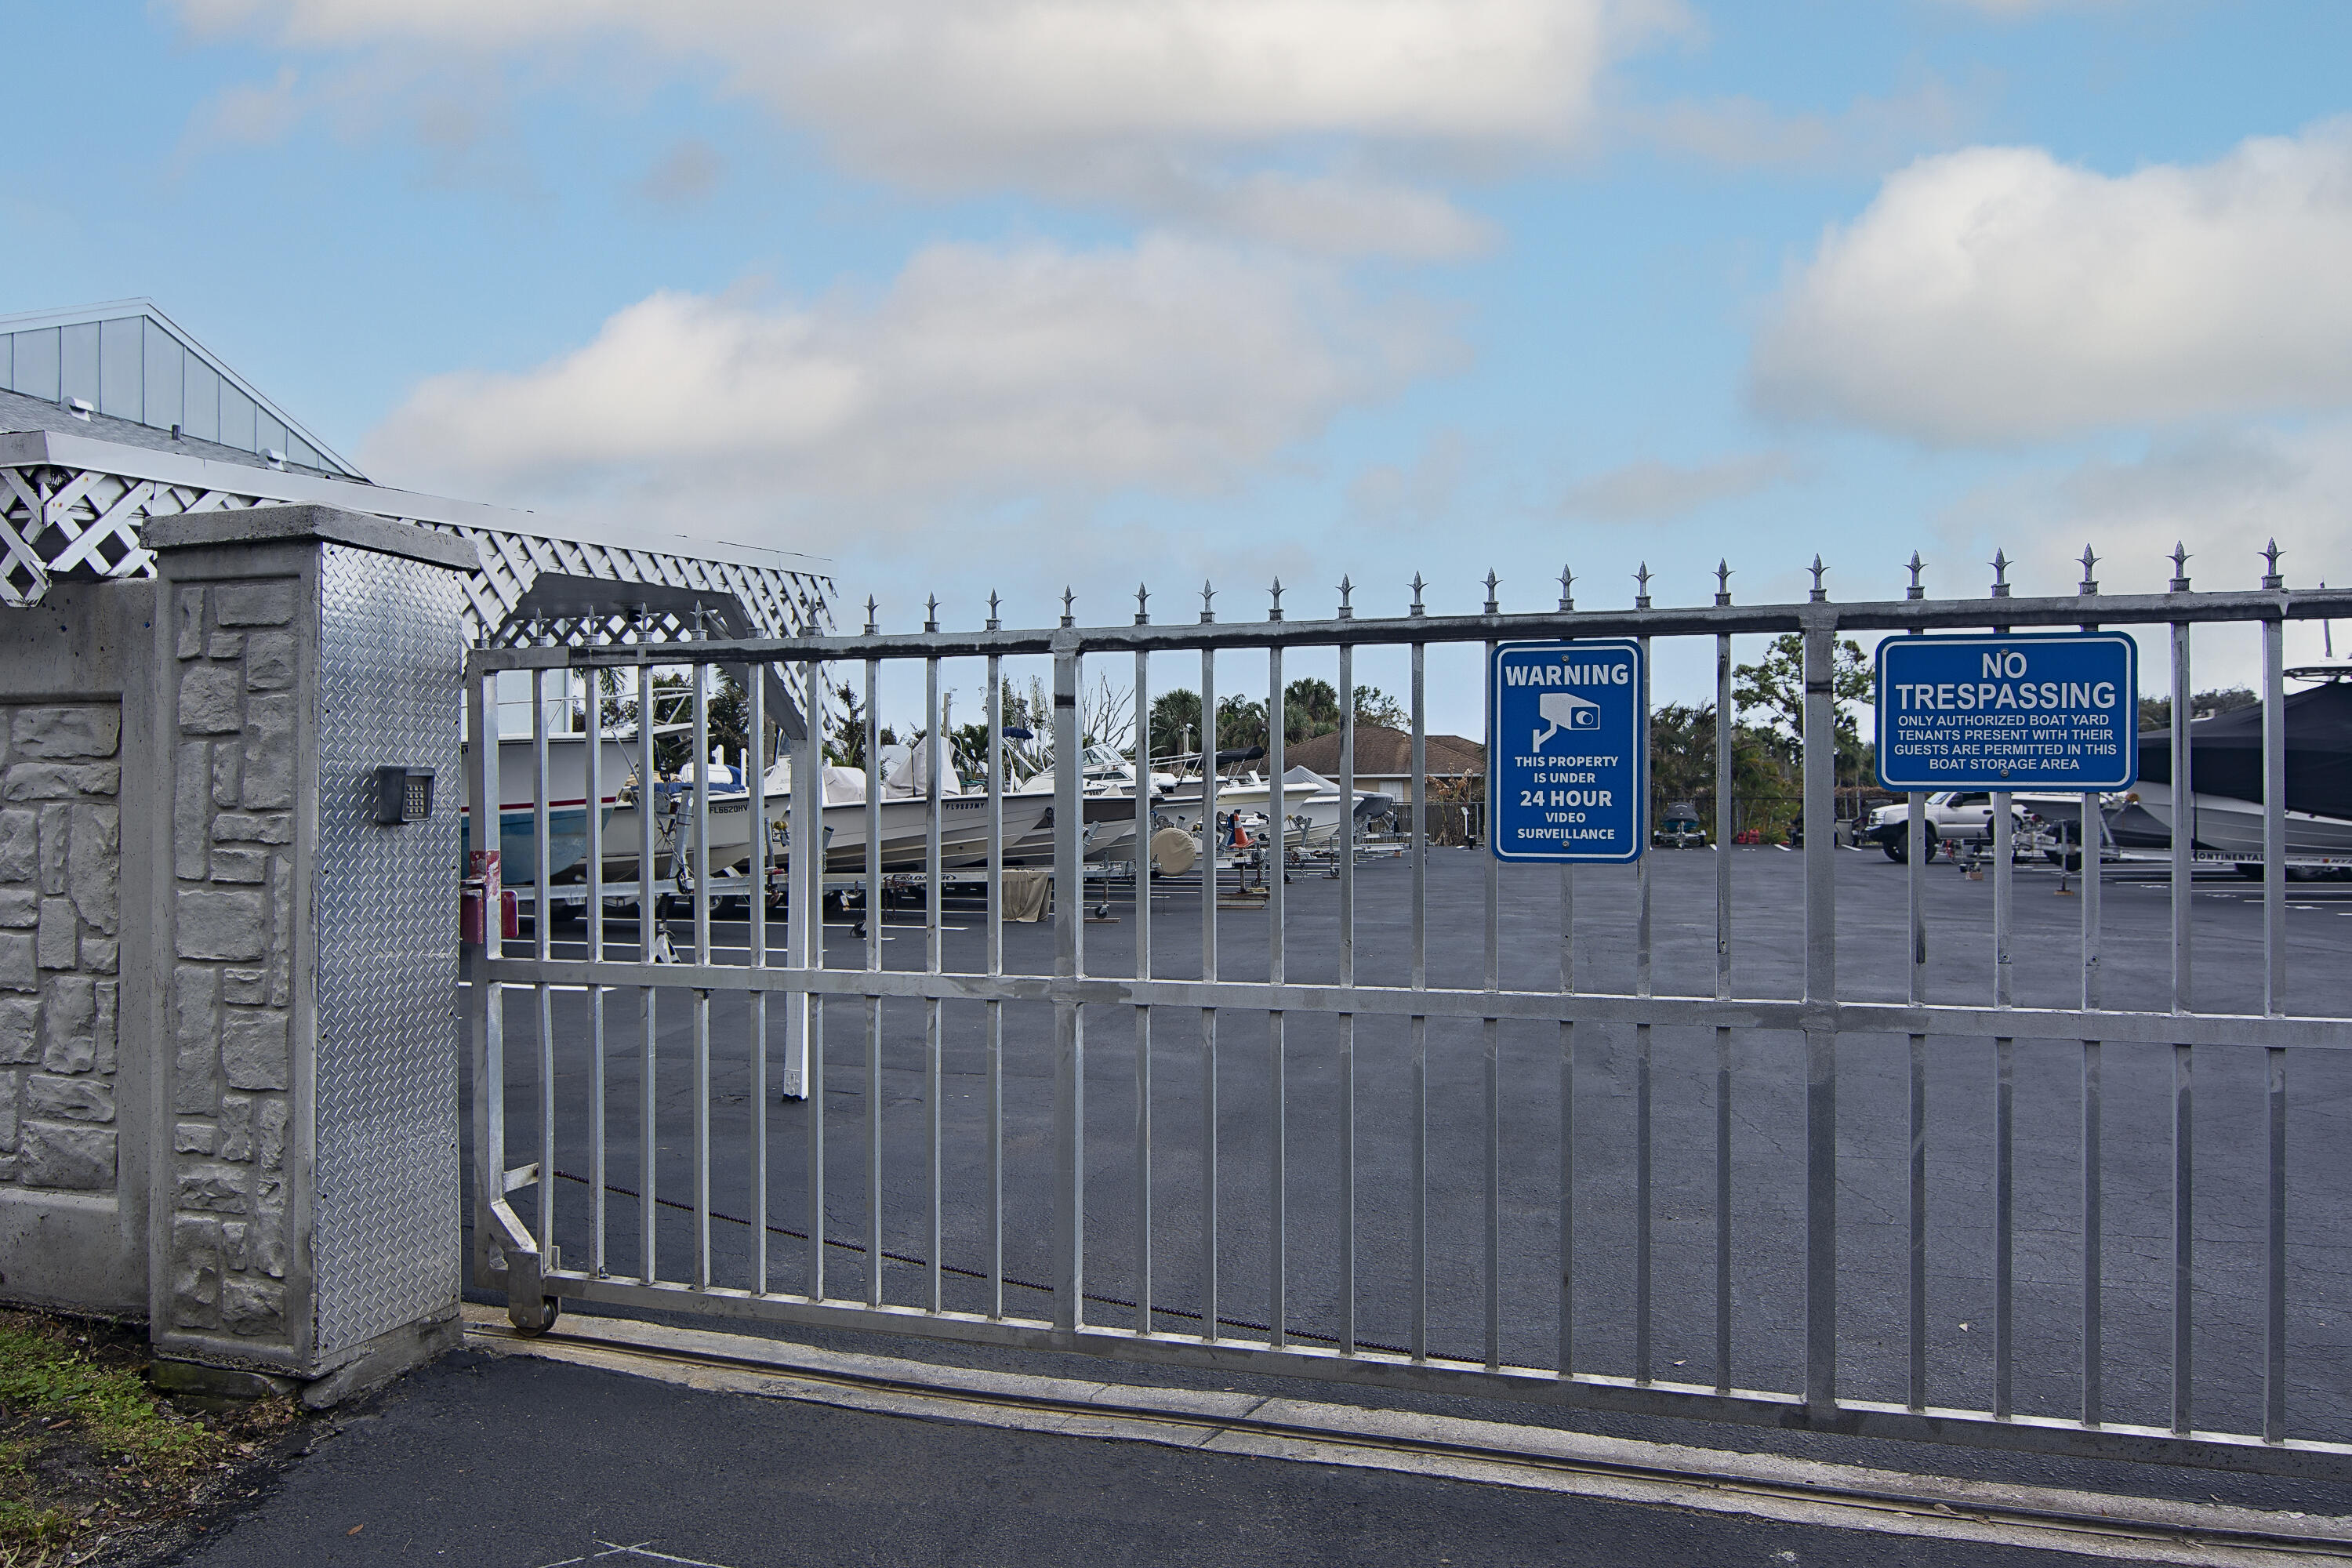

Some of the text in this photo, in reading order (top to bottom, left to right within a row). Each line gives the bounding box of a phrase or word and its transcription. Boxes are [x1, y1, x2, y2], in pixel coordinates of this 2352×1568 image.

[1983, 652, 2027, 679] NO
[1505, 664, 1628, 686] WARNING
[1896, 682, 2115, 710] TRESPASSING
[1898, 714, 2109, 726] ONLY AUTHORIZED BOAT YARD
[1898, 729, 2114, 741] TENANTS PRESENT WITH THEIR
[1894, 744, 2117, 755] GUESTS ARE PERMITTED IN THIS
[1515, 756, 1619, 767] THIS PROPERTY
[1929, 759, 2080, 770] BOAT STORAGE AREA
[1534, 773, 1595, 783] IS UNDER
[1520, 790, 1613, 807] 24 HOUR
[1545, 812, 1586, 822] VIDEO
[1518, 829, 1615, 839] SURVEILLANCE
